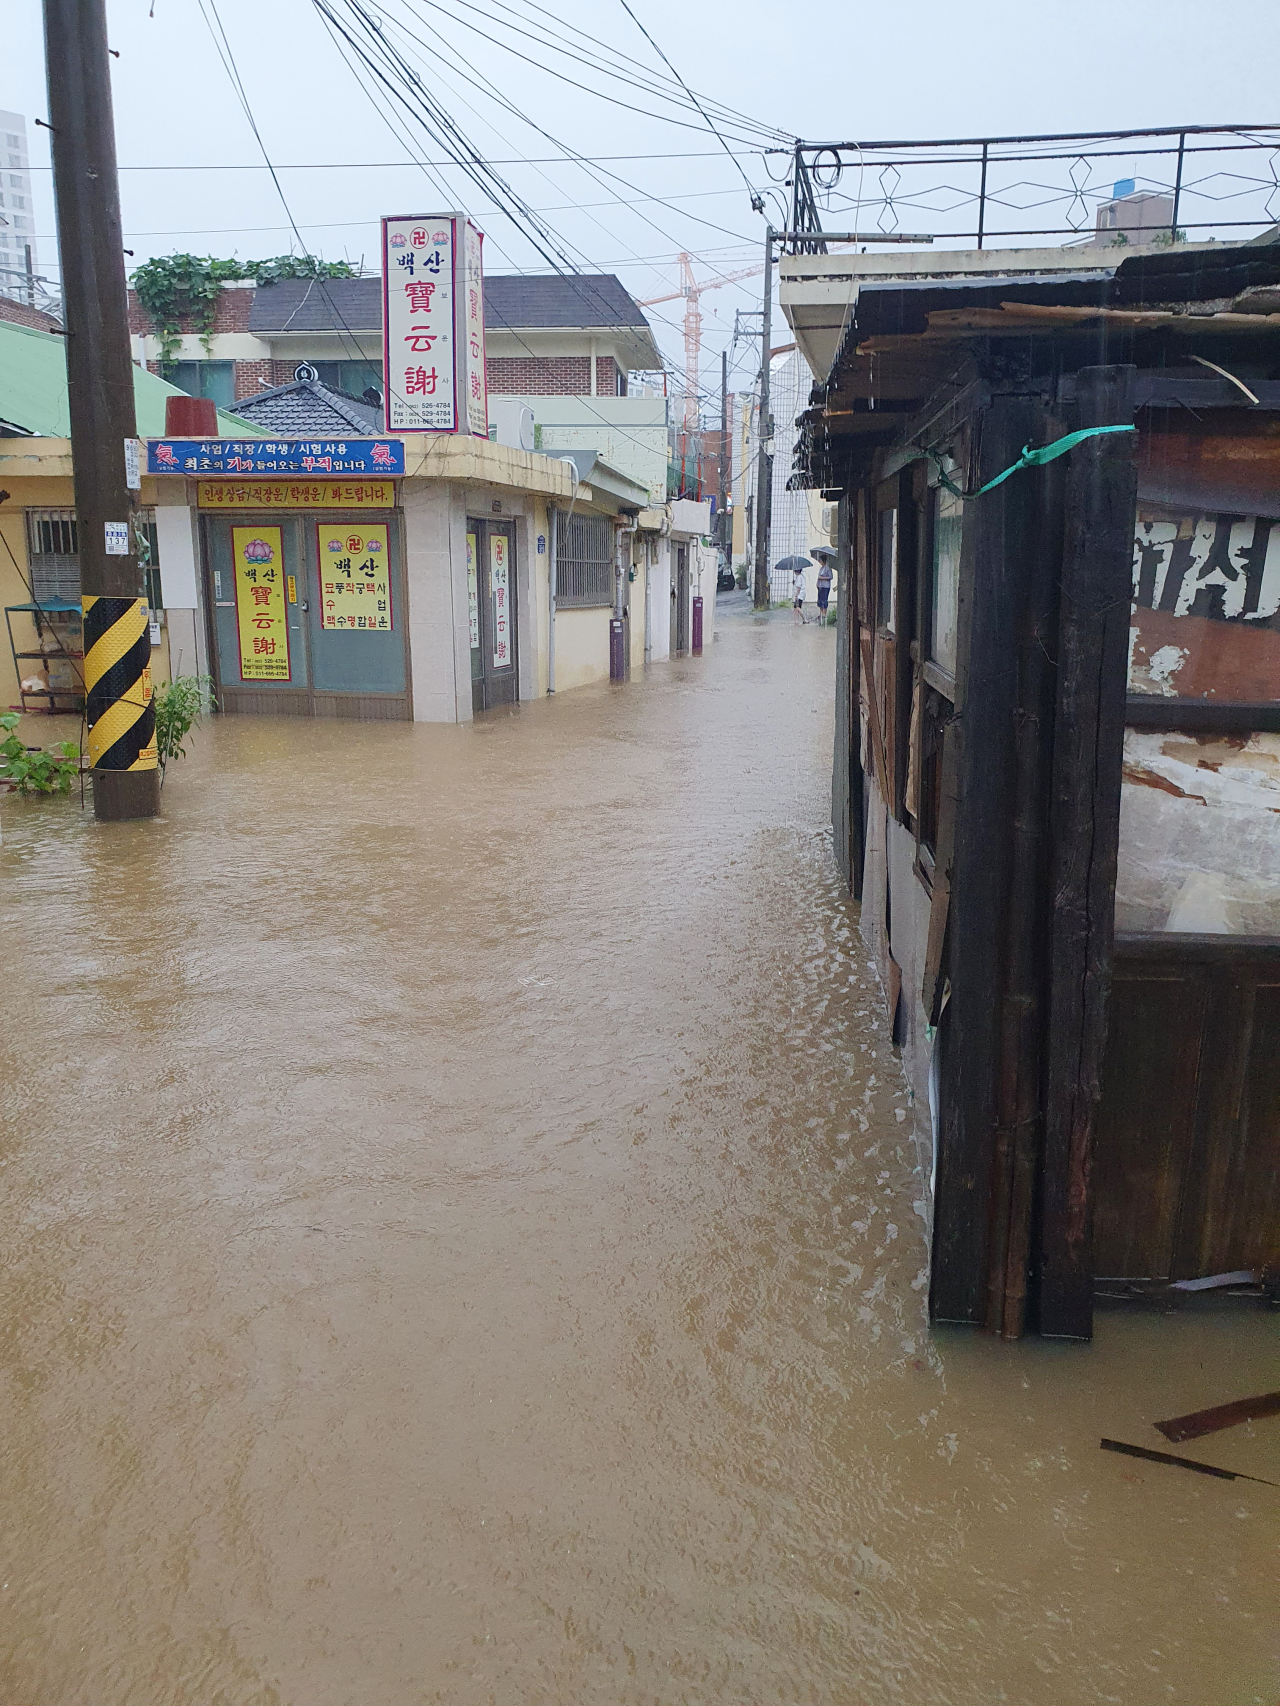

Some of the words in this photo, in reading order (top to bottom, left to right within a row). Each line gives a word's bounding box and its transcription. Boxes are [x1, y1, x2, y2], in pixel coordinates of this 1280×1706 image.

[396, 250, 445, 275] 백산
[200, 444, 222, 455] 사업
[232, 444, 255, 455] 직장
[266, 444, 288, 455] 학생
[299, 444, 322, 455] 시험
[324, 444, 348, 455] 사용
[109, 537, 126, 545] 137
[333, 557, 379, 578] 백산
